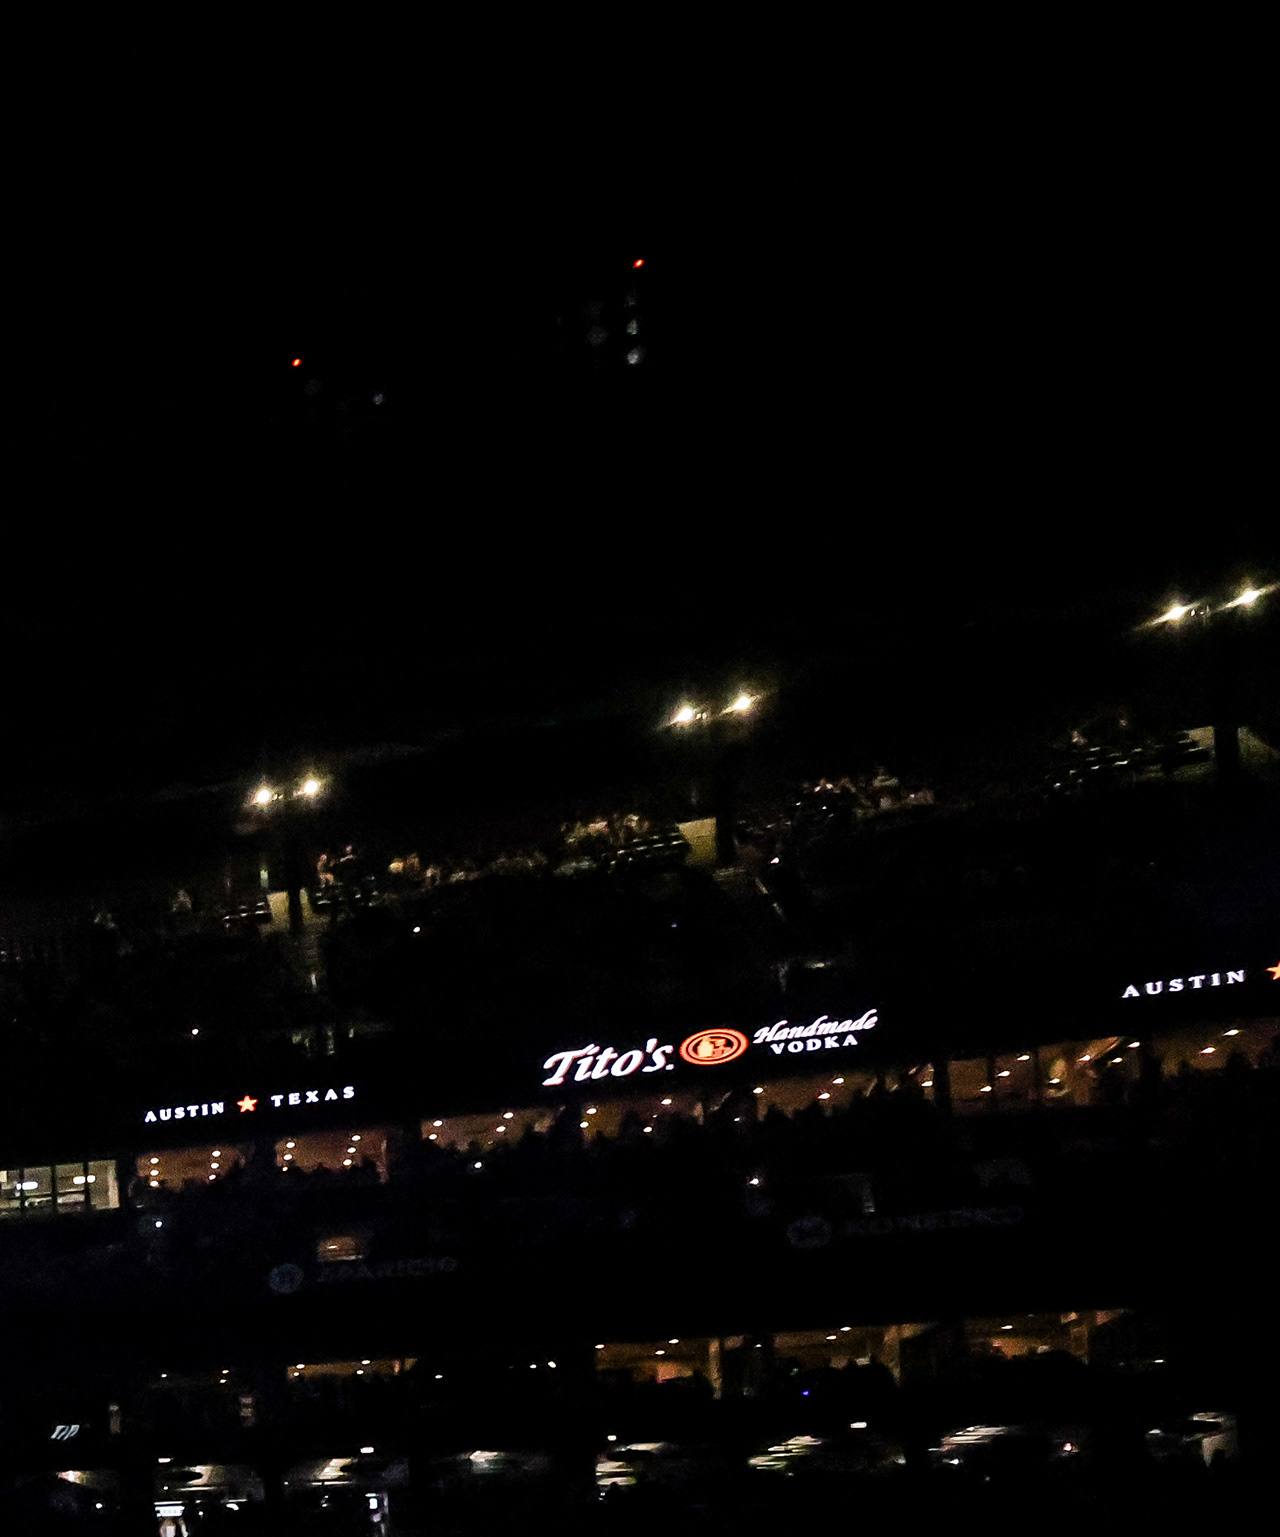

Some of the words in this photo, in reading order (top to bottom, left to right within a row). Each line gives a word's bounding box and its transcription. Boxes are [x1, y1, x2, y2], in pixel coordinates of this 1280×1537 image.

[1121, 969, 1245, 999] AUSTIN
[541, 1037, 675, 1086] Tito's
[752, 1008, 879, 1044] Handmade
[770, 1034, 859, 1055] VODKA
[144, 1101, 225, 1123] AUSTIN
[270, 1085, 355, 1108] TEXAS
